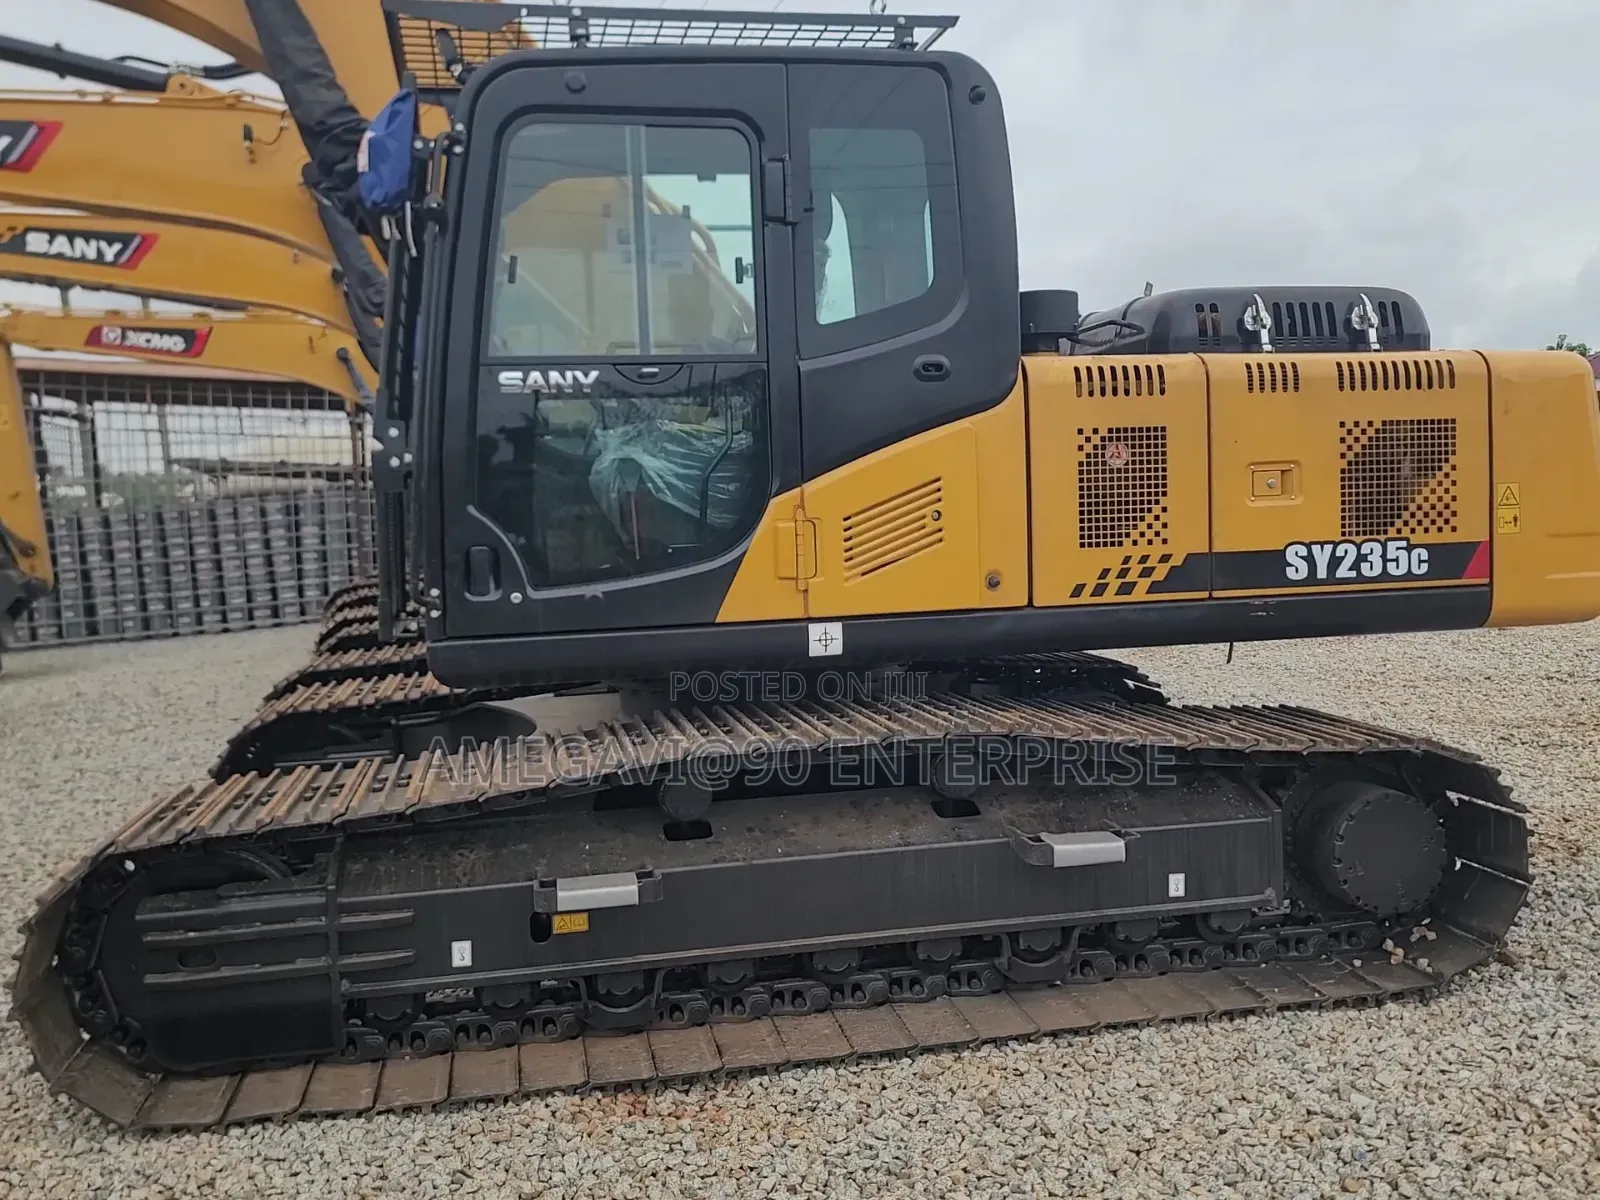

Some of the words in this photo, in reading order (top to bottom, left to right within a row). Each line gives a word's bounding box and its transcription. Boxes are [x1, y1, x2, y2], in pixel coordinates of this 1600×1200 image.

[25, 230, 123, 263] SANY
[122, 329, 186, 353] XCMG
[498, 370, 600, 394] SANY
